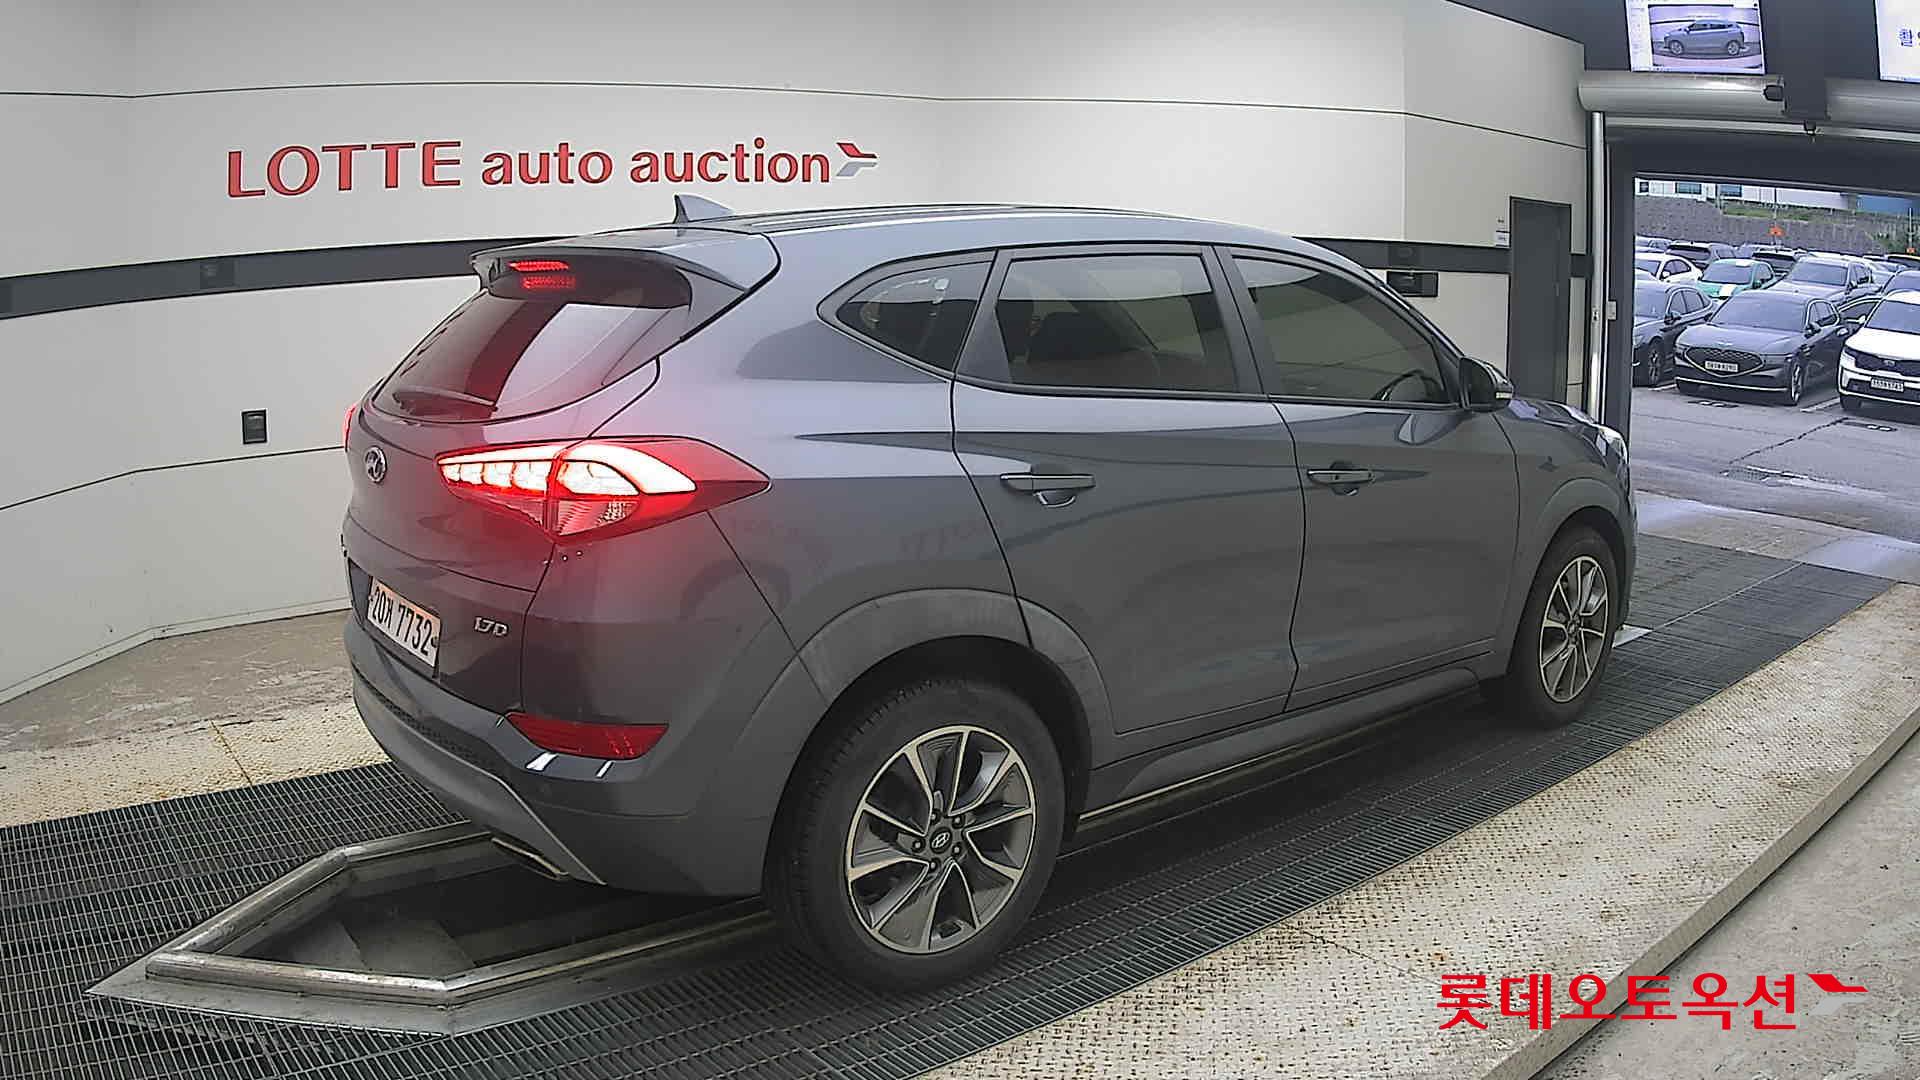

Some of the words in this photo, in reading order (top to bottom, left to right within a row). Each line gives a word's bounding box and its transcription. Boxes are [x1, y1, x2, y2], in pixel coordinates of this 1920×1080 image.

[227, 140, 462, 198] LOTTE
[481, 141, 613, 186] auto
[629, 137, 830, 184] auction
[396, 602, 433, 657] 7732
